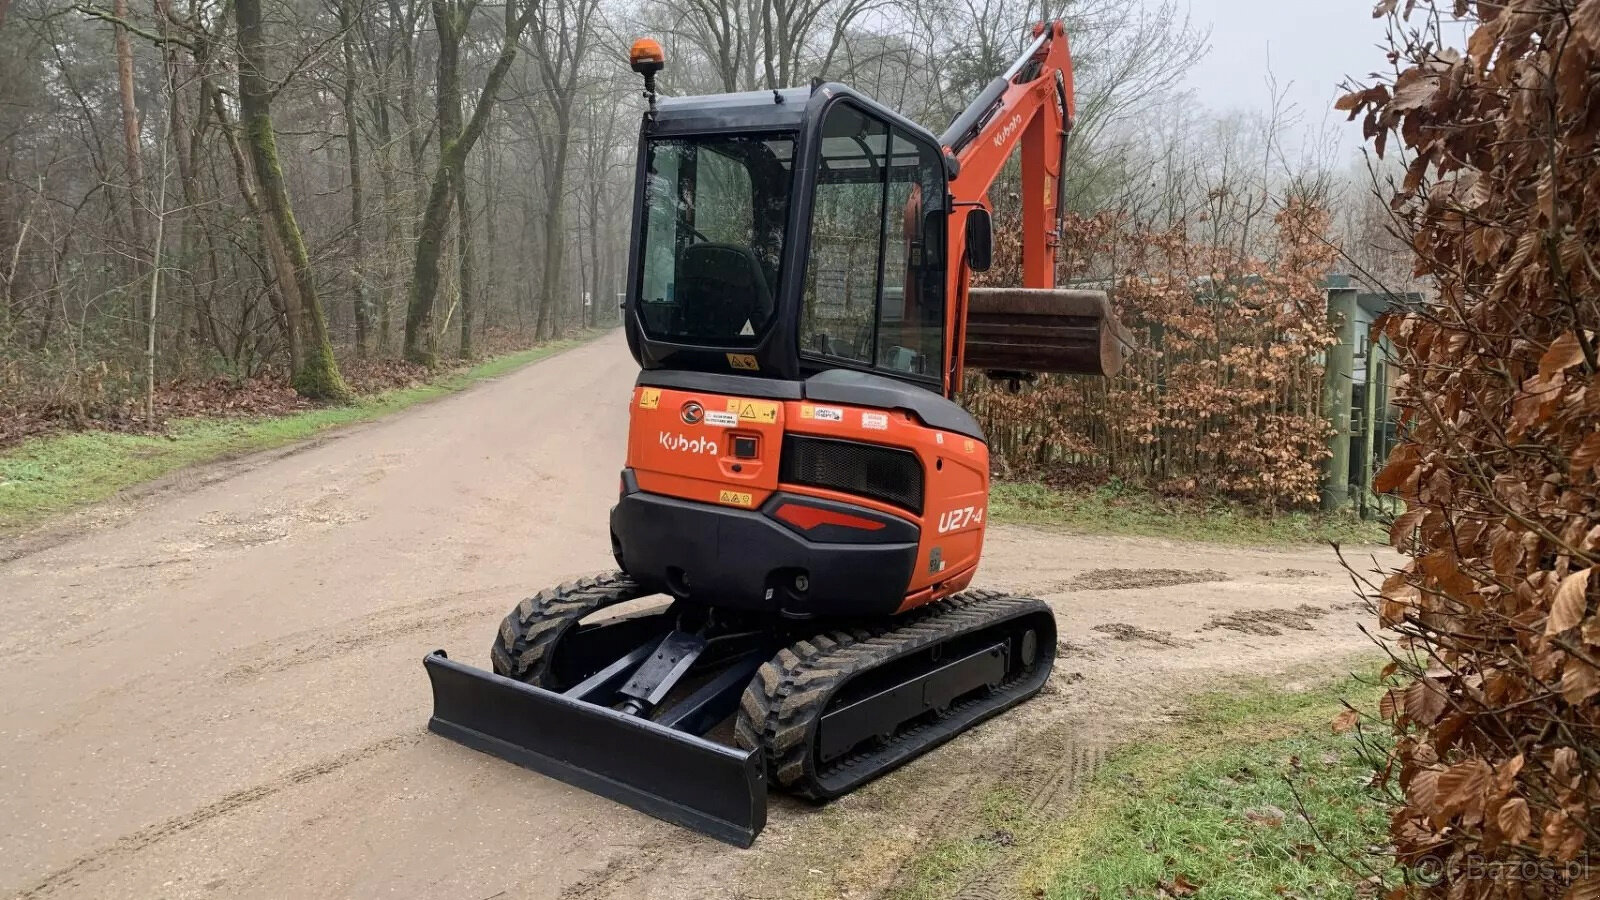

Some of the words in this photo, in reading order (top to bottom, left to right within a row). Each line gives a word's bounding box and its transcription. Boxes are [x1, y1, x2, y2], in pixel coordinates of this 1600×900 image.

[993, 114, 1022, 147] Kubota
[659, 431, 718, 455] Kubota
[937, 506, 983, 533] U27-4
